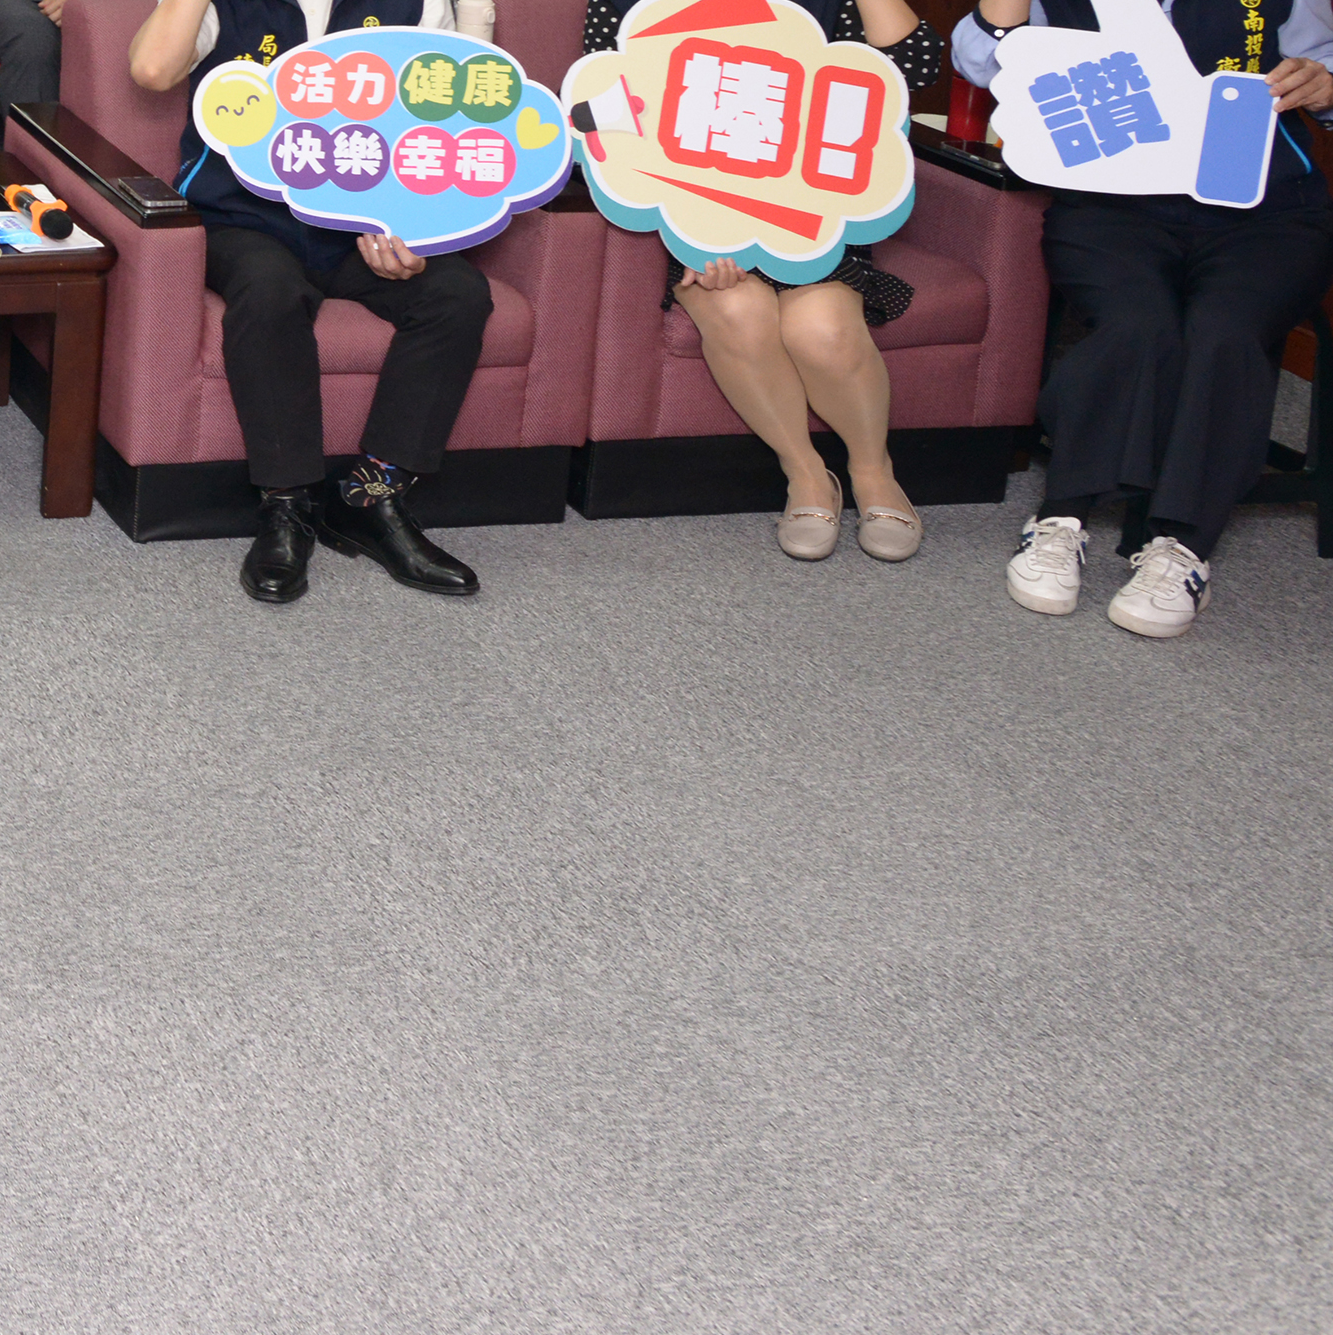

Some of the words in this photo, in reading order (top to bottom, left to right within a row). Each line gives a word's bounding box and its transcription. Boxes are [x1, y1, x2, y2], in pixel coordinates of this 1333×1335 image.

[290, 63, 386, 105] 活力
[403, 60, 513, 107] 健康
[1028, 51, 1171, 168] 讚
[275, 129, 384, 176] 快樂
[398, 135, 506, 183] 幸福
